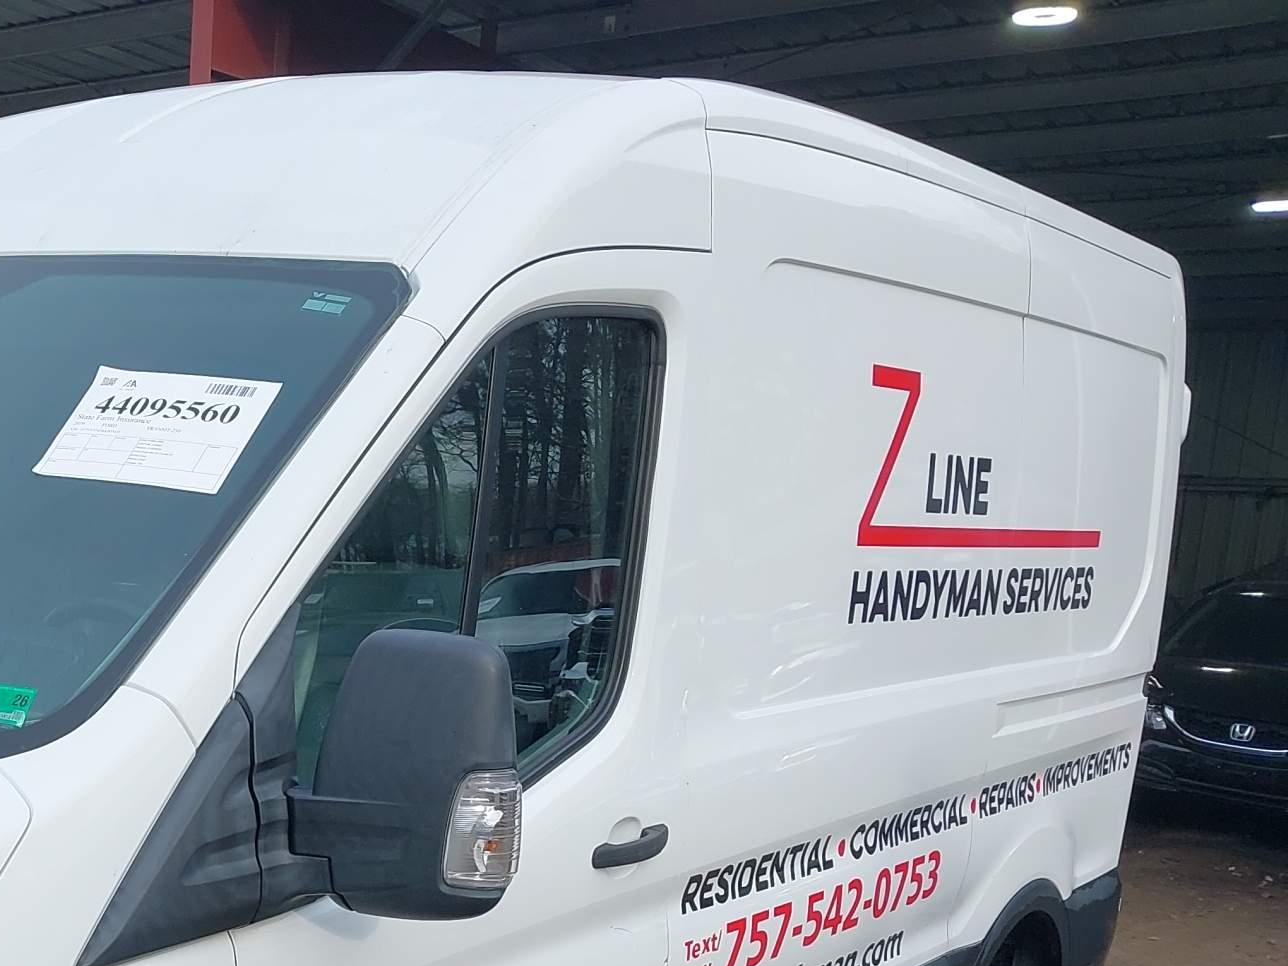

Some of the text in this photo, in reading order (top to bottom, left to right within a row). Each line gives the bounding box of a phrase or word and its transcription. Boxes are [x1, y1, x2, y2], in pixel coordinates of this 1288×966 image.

[94, 395, 241, 425] 44095560
[856, 364, 1101, 547] Z LINE
[848, 566, 1094, 624] HANDYMAN SERVICES
[12, 694, 30, 707] 26
[681, 742, 1132, 914] RESIDENTIAL COMMERCIAL REPAIRS IMPROVEMENTS
[684, 928, 722, 962] Text/
